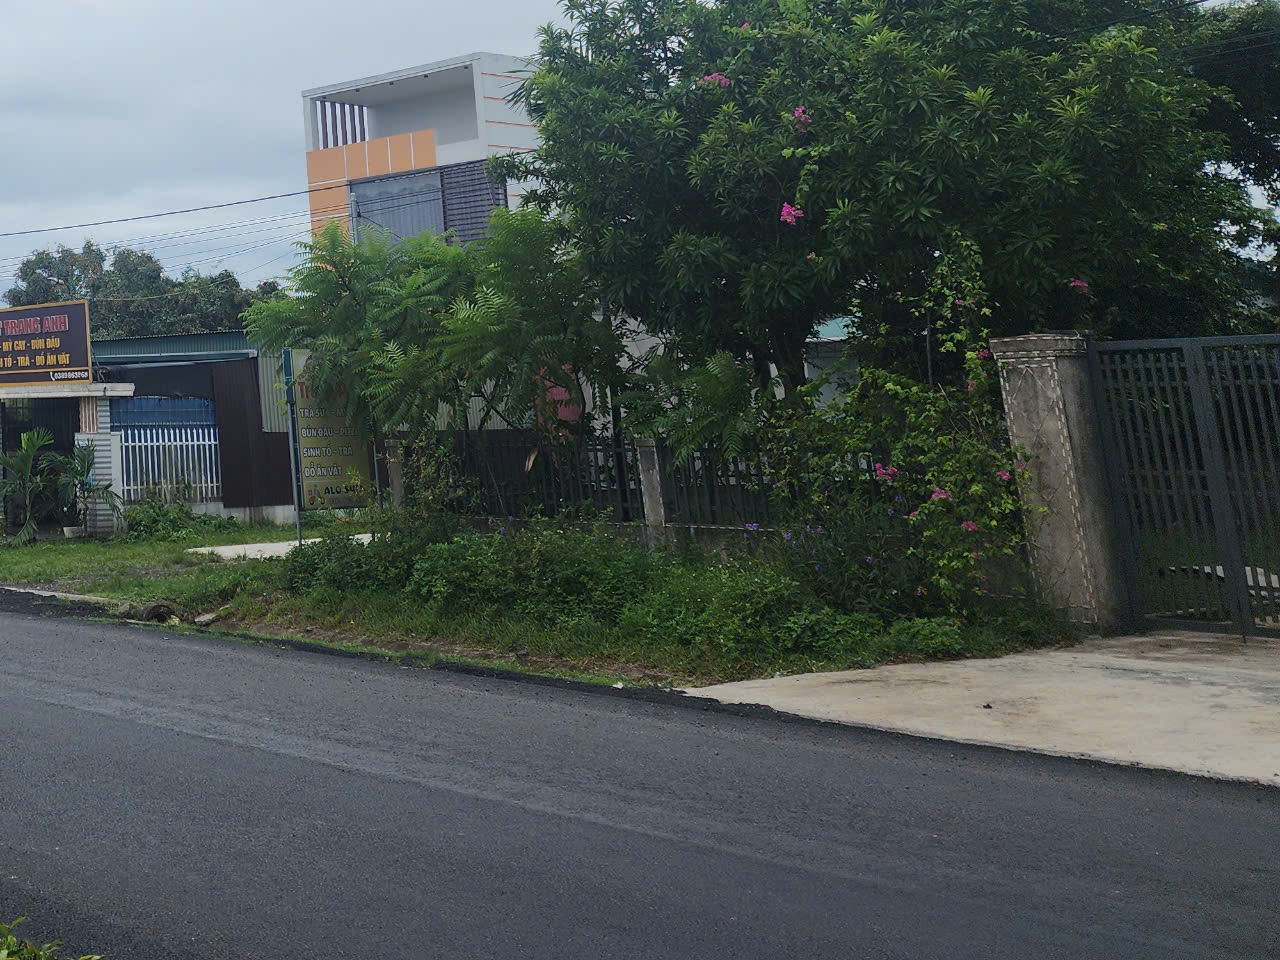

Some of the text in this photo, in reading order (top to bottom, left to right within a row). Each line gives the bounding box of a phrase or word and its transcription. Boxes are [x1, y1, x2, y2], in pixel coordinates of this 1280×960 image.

[4, 317, 41, 336] TRANG
[43, 314, 69, 333] ANH
[301, 425, 317, 438] BÚN
[303, 447, 321, 457] SINH
[324, 485, 341, 495] ALO
